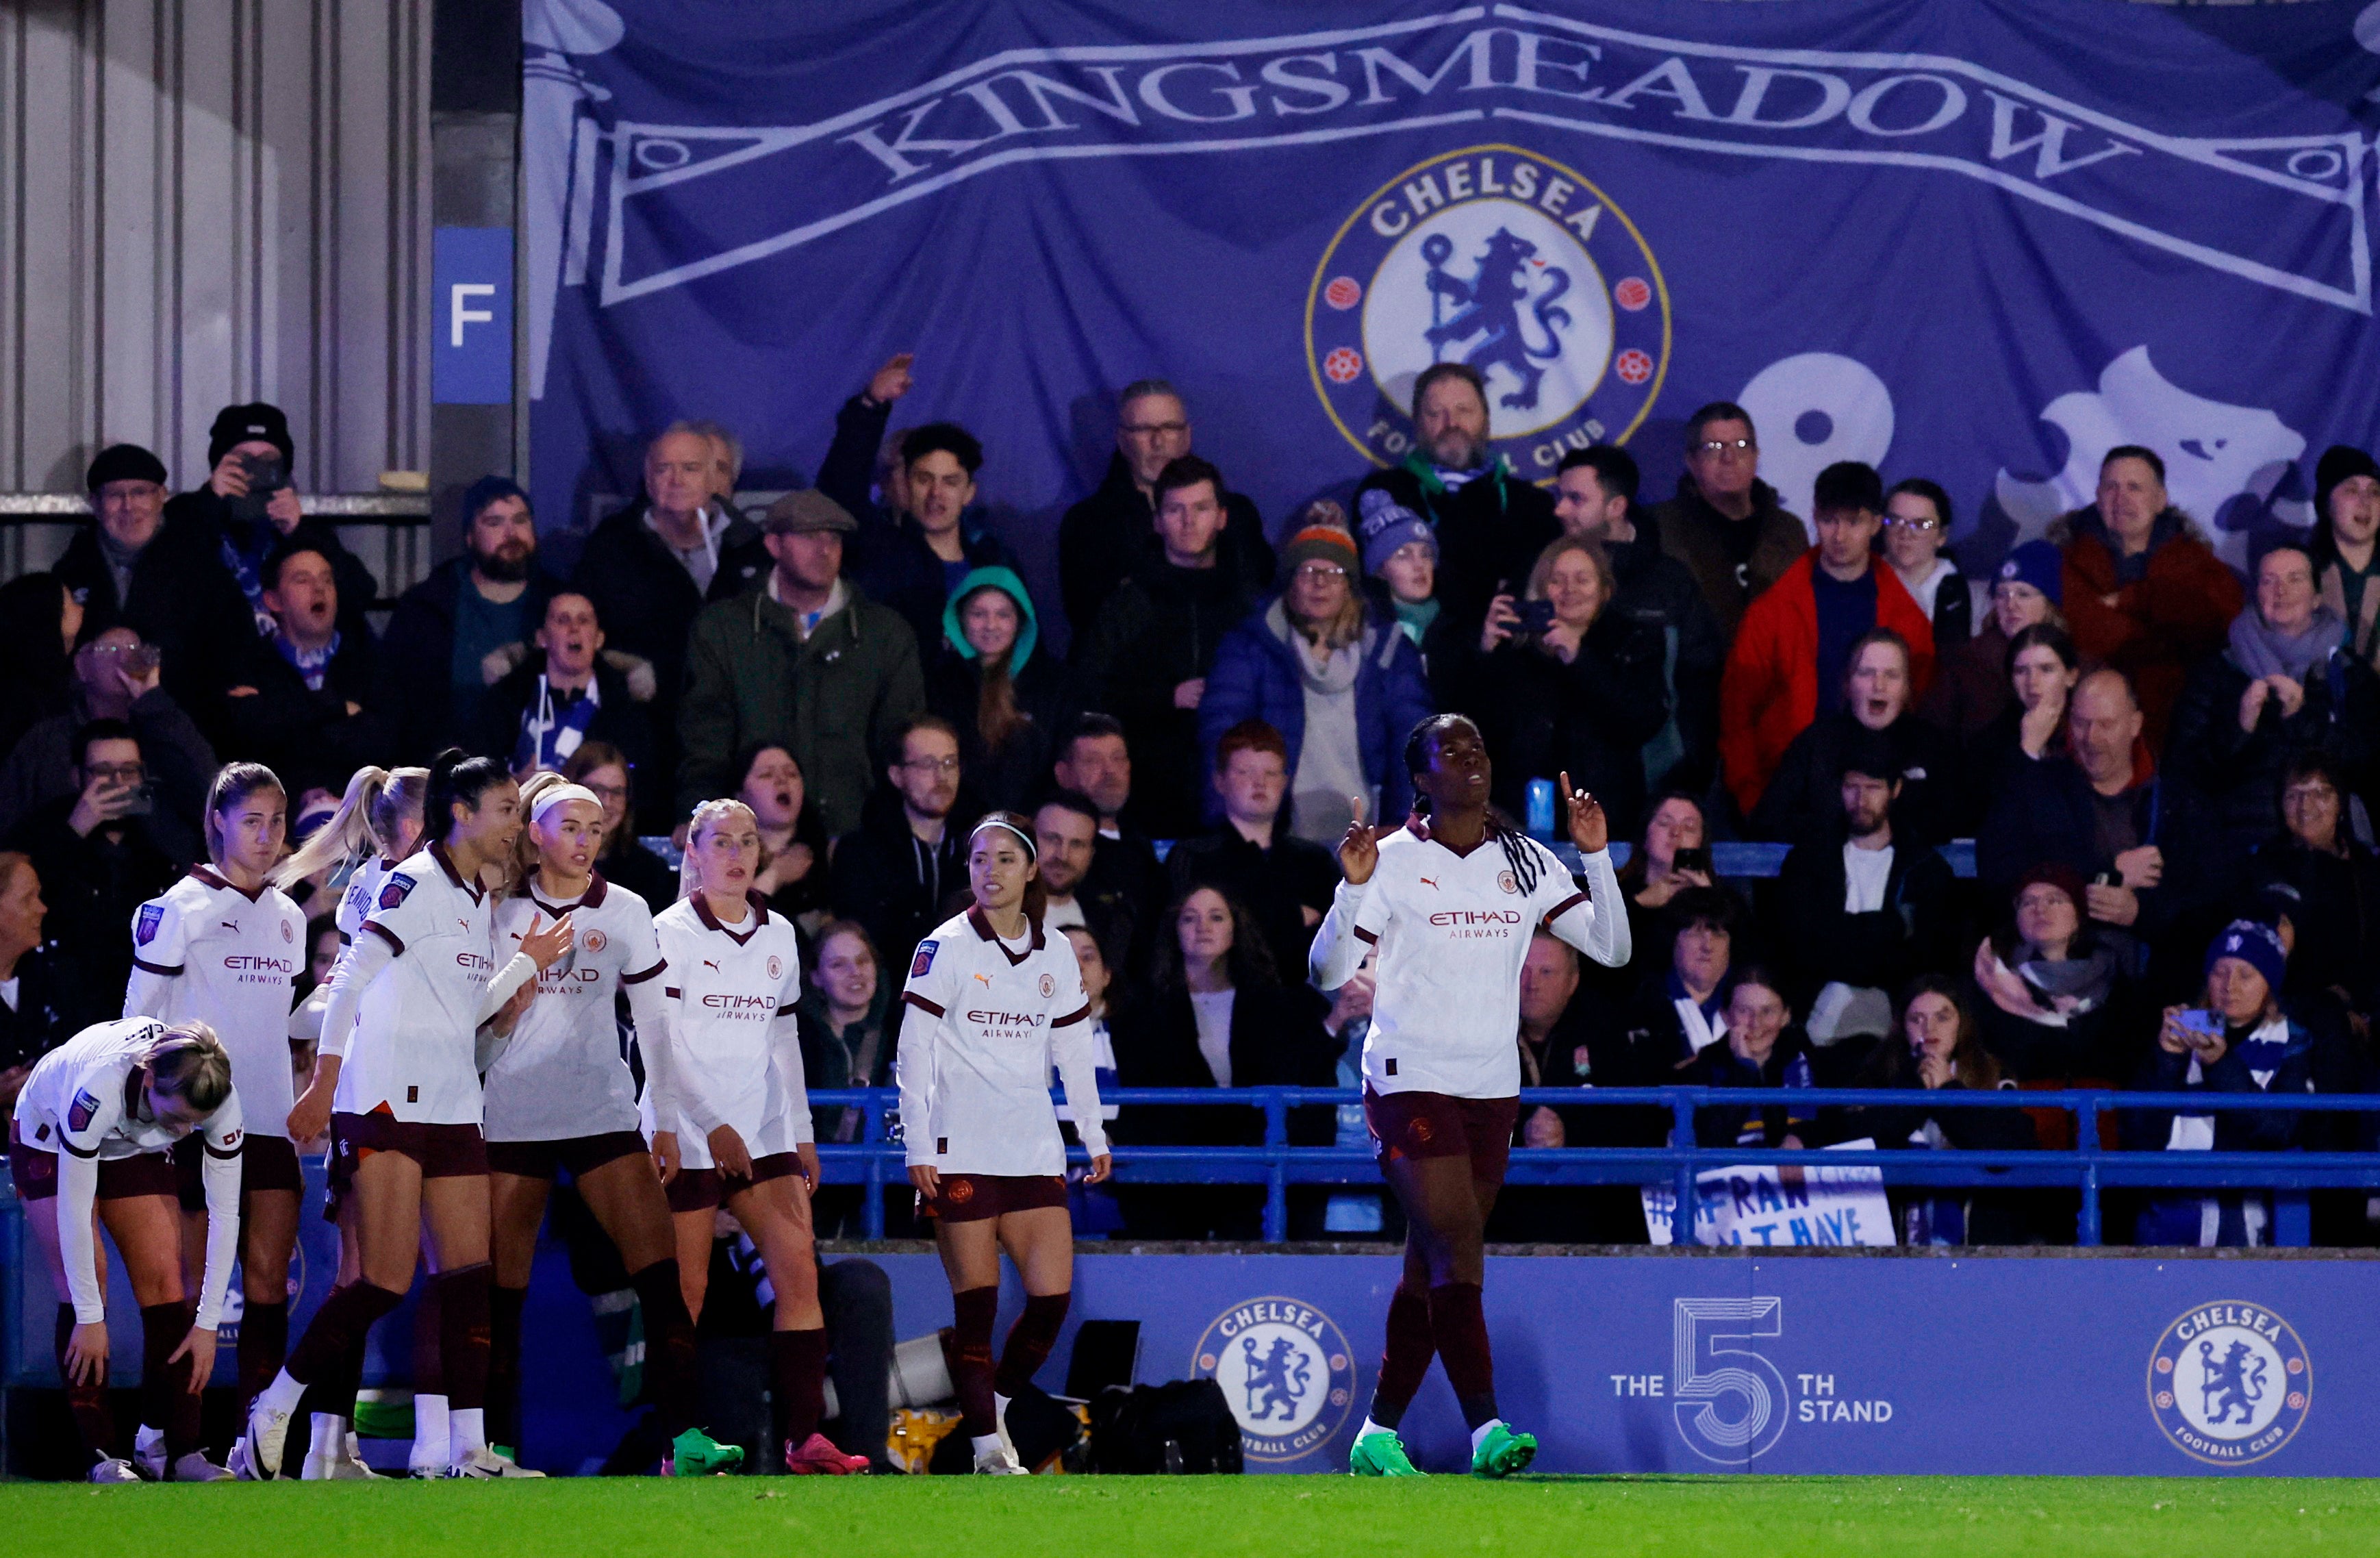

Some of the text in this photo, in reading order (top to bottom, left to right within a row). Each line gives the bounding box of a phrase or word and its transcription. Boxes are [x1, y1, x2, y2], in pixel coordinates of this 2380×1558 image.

[836, 29, 2142, 184] KINGSMEADOW
[1370, 158, 1604, 242] CHELSEA
[451, 284, 495, 347] F
[1429, 910, 1521, 926] ETIHAD
[1449, 929, 1509, 939] AIRWAYS
[224, 956, 292, 972] ETIHAD
[238, 975, 283, 985] AIRWAYS
[538, 968, 599, 982] IHAD
[538, 986, 583, 995] RWAYS
[702, 994, 776, 1009] ETIHAD
[716, 1010, 765, 1022] AIRWAYS
[967, 1010, 1046, 1027] ETIHAD
[982, 1029, 1032, 1039] AIRWAY
[1789, 1207, 1865, 1246] HAVE
[1219, 1303, 1324, 1339] CHELSEA
[2177, 1307, 2282, 1342] CHELSEA
[1610, 1296, 1835, 1464] THE 5 TH
[1799, 1400, 1893, 1422] STAND
[1293, 1423, 1327, 1448] CLUB
[2175, 1426, 2284, 1457] FOOTBALL CLUB
